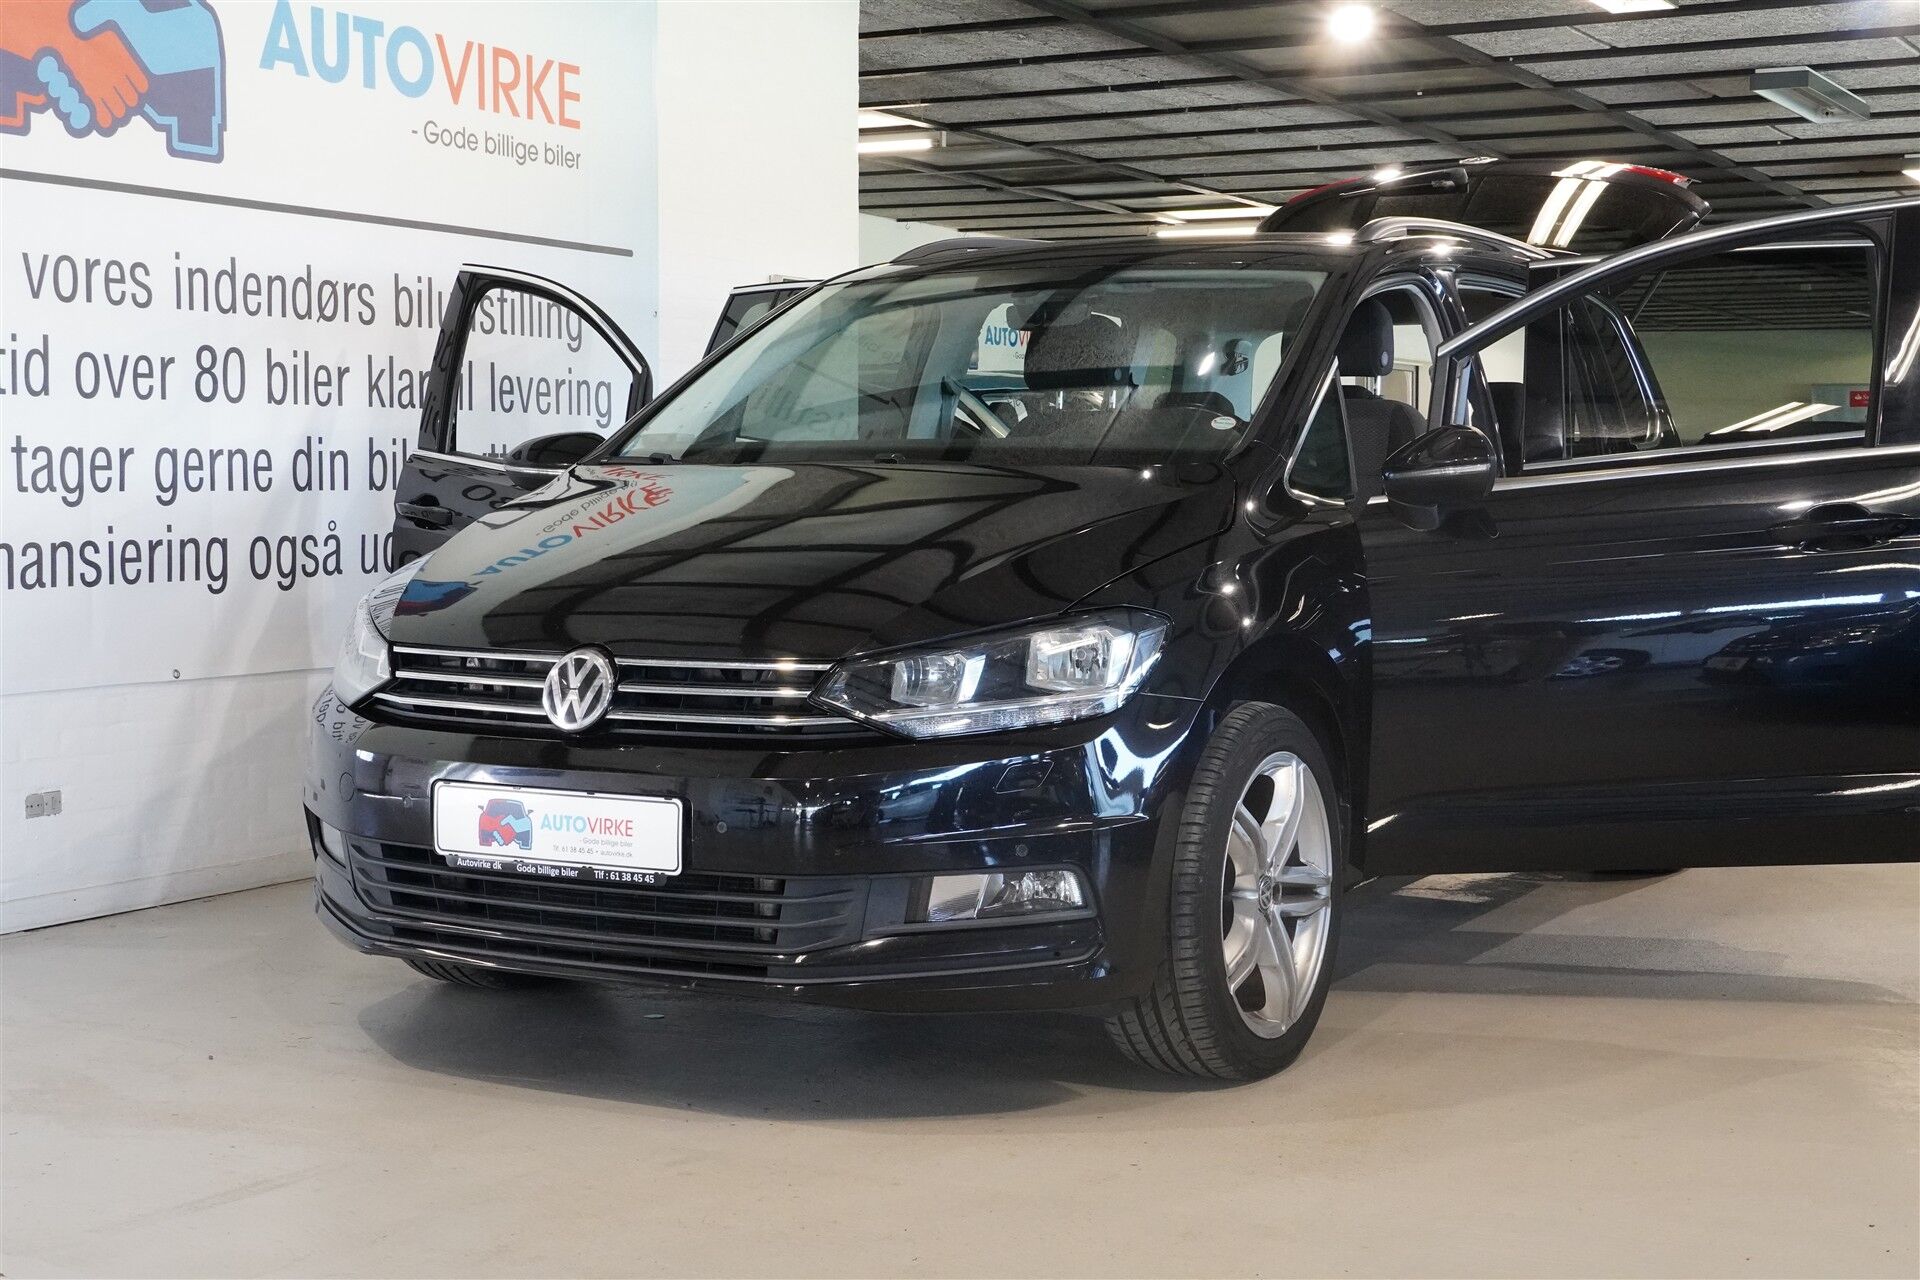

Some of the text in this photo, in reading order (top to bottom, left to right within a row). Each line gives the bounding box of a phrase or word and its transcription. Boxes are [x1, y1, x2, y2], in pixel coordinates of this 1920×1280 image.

[259, 0, 581, 130] AUTOVIRKE
[423, 120, 479, 152] Gode
[484, 131, 539, 166] billige
[544, 142, 582, 170] biler
[22, 252, 153, 309] vores
[174, 251, 377, 326] indendørs
[75, 351, 176, 401] over
[194, 344, 246, 404] 80
[266, 347, 351, 408] biler
[490, 361, 613, 429] levering
[10, 435, 135, 508] tager
[154, 447, 273, 507] gerne
[292, 435, 349, 493] din
[249, 519, 344, 592] også
[540, 813, 633, 837] AUTOVIRKE
[456, 858, 491, 869] Autovirke
[516, 863, 536, 873] Gode
[537, 864, 560, 877] billige
[560, 867, 579, 878] biler
[610, 871, 620, 881] 61
[621, 872, 632, 882] 38
[632, 873, 643, 883] 45
[644, 874, 655, 884] 45
